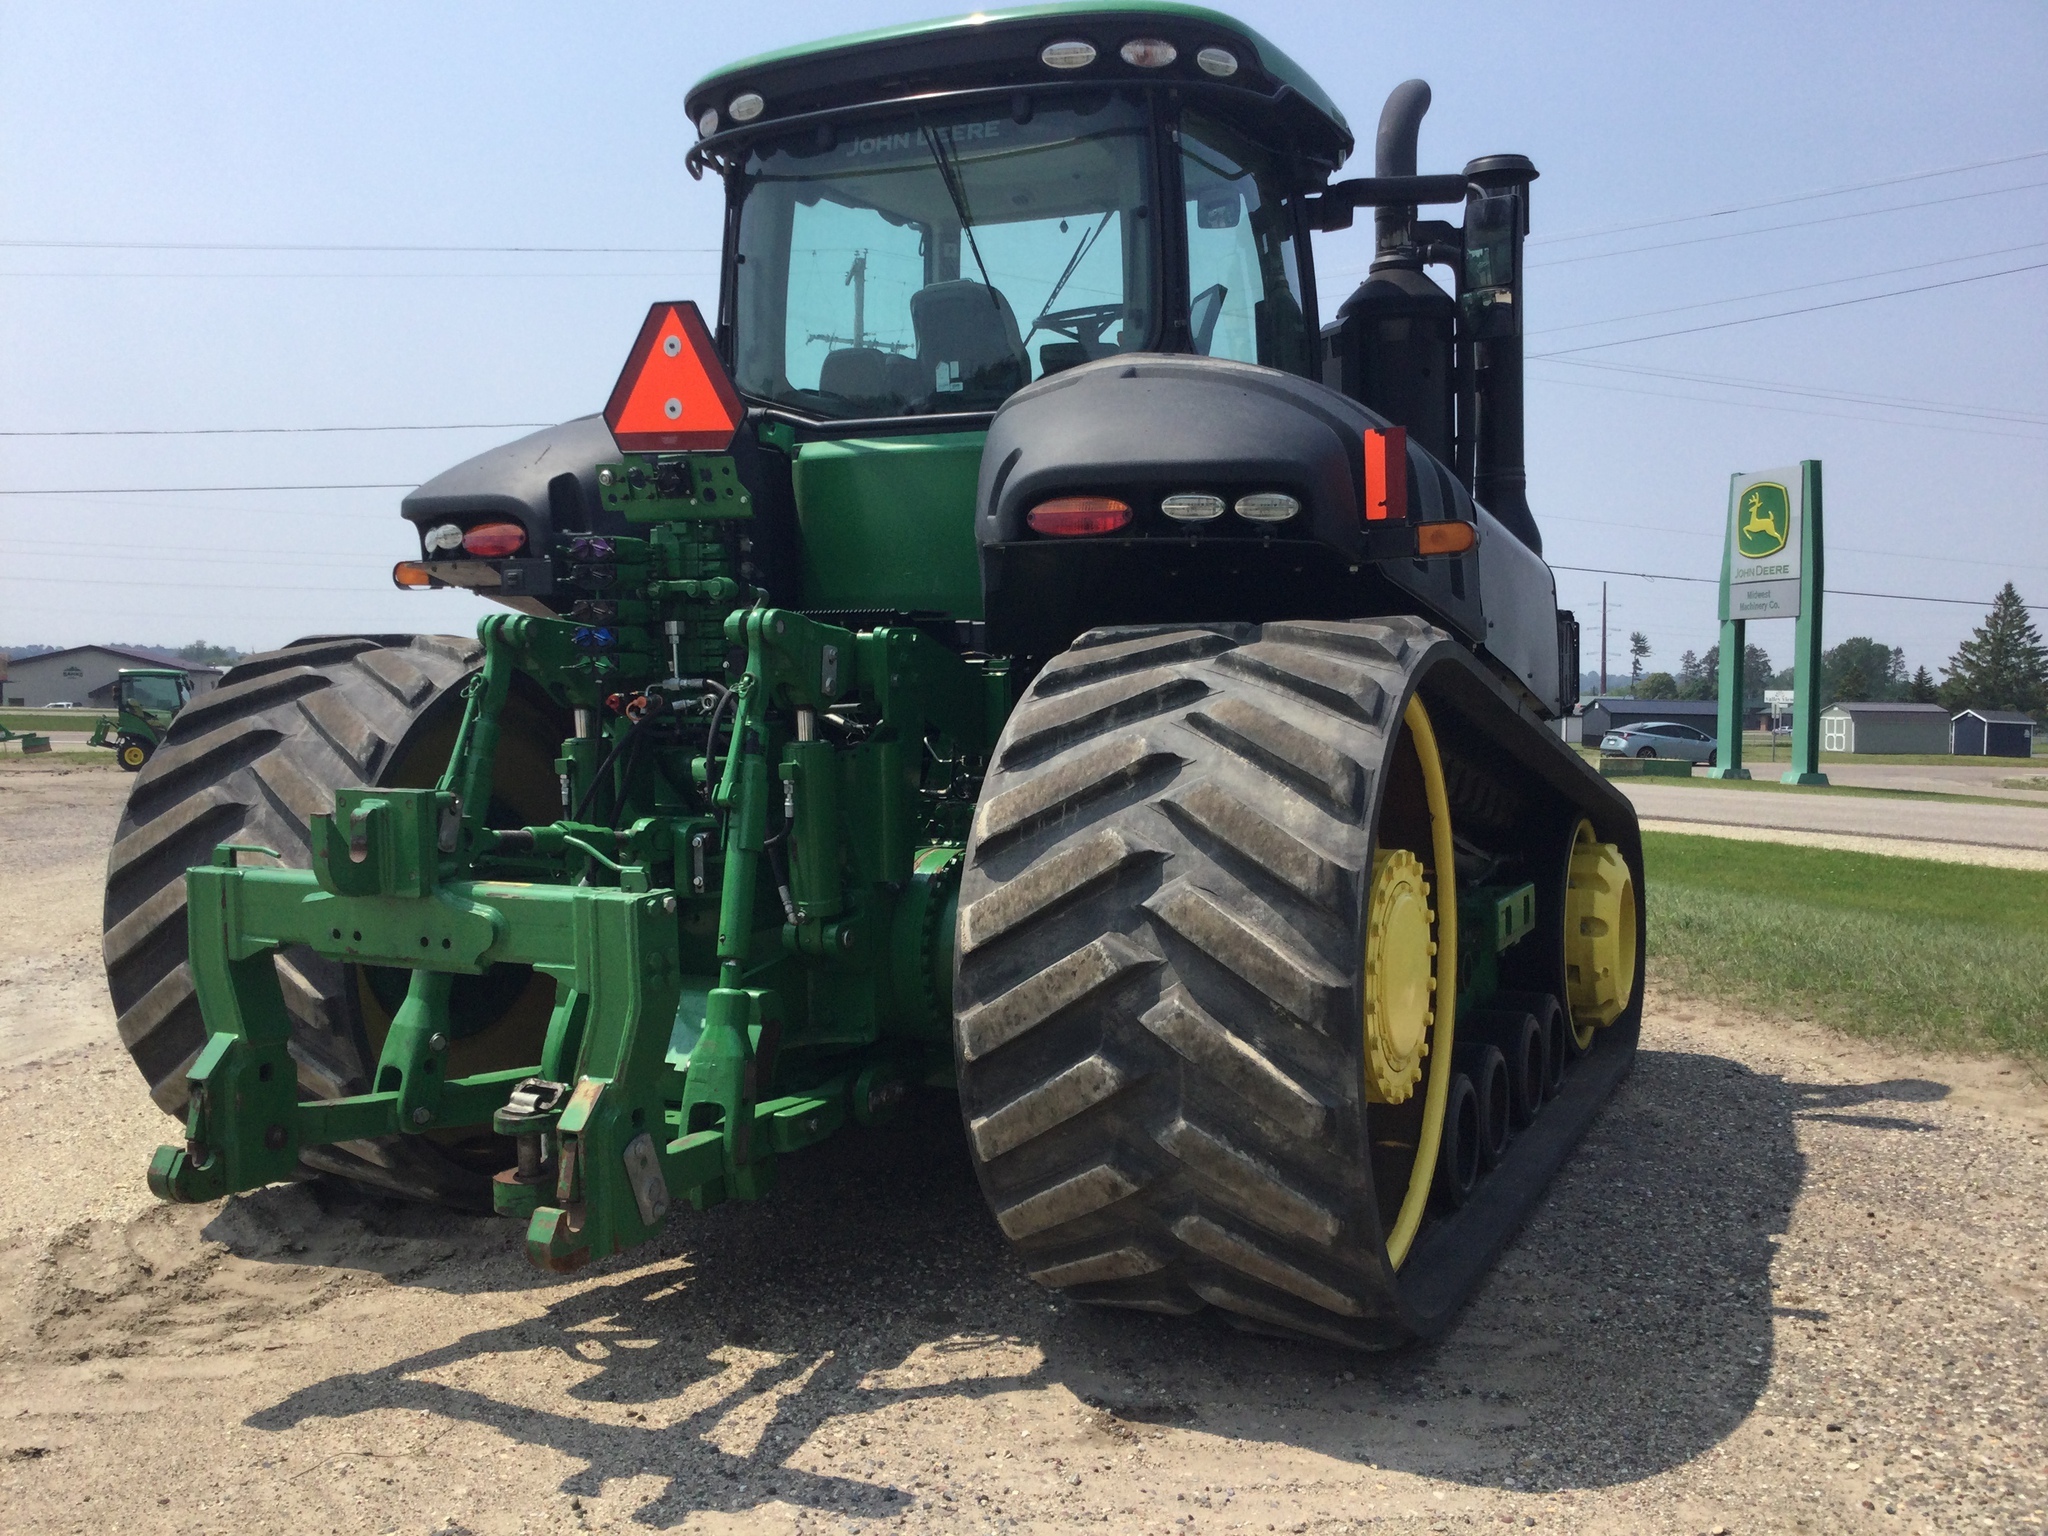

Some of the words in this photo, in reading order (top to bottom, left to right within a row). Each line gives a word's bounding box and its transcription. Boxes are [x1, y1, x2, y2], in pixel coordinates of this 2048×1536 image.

[846, 132, 910, 157] JOHN
[916, 119, 1000, 146] DEERE
[1735, 567, 1755, 579] JOHN
[1755, 564, 1790, 576] DEERE
[1747, 590, 1771, 600] Midwest
[1740, 601, 1768, 611] Machinery
[1769, 600, 1780, 609] Co.
